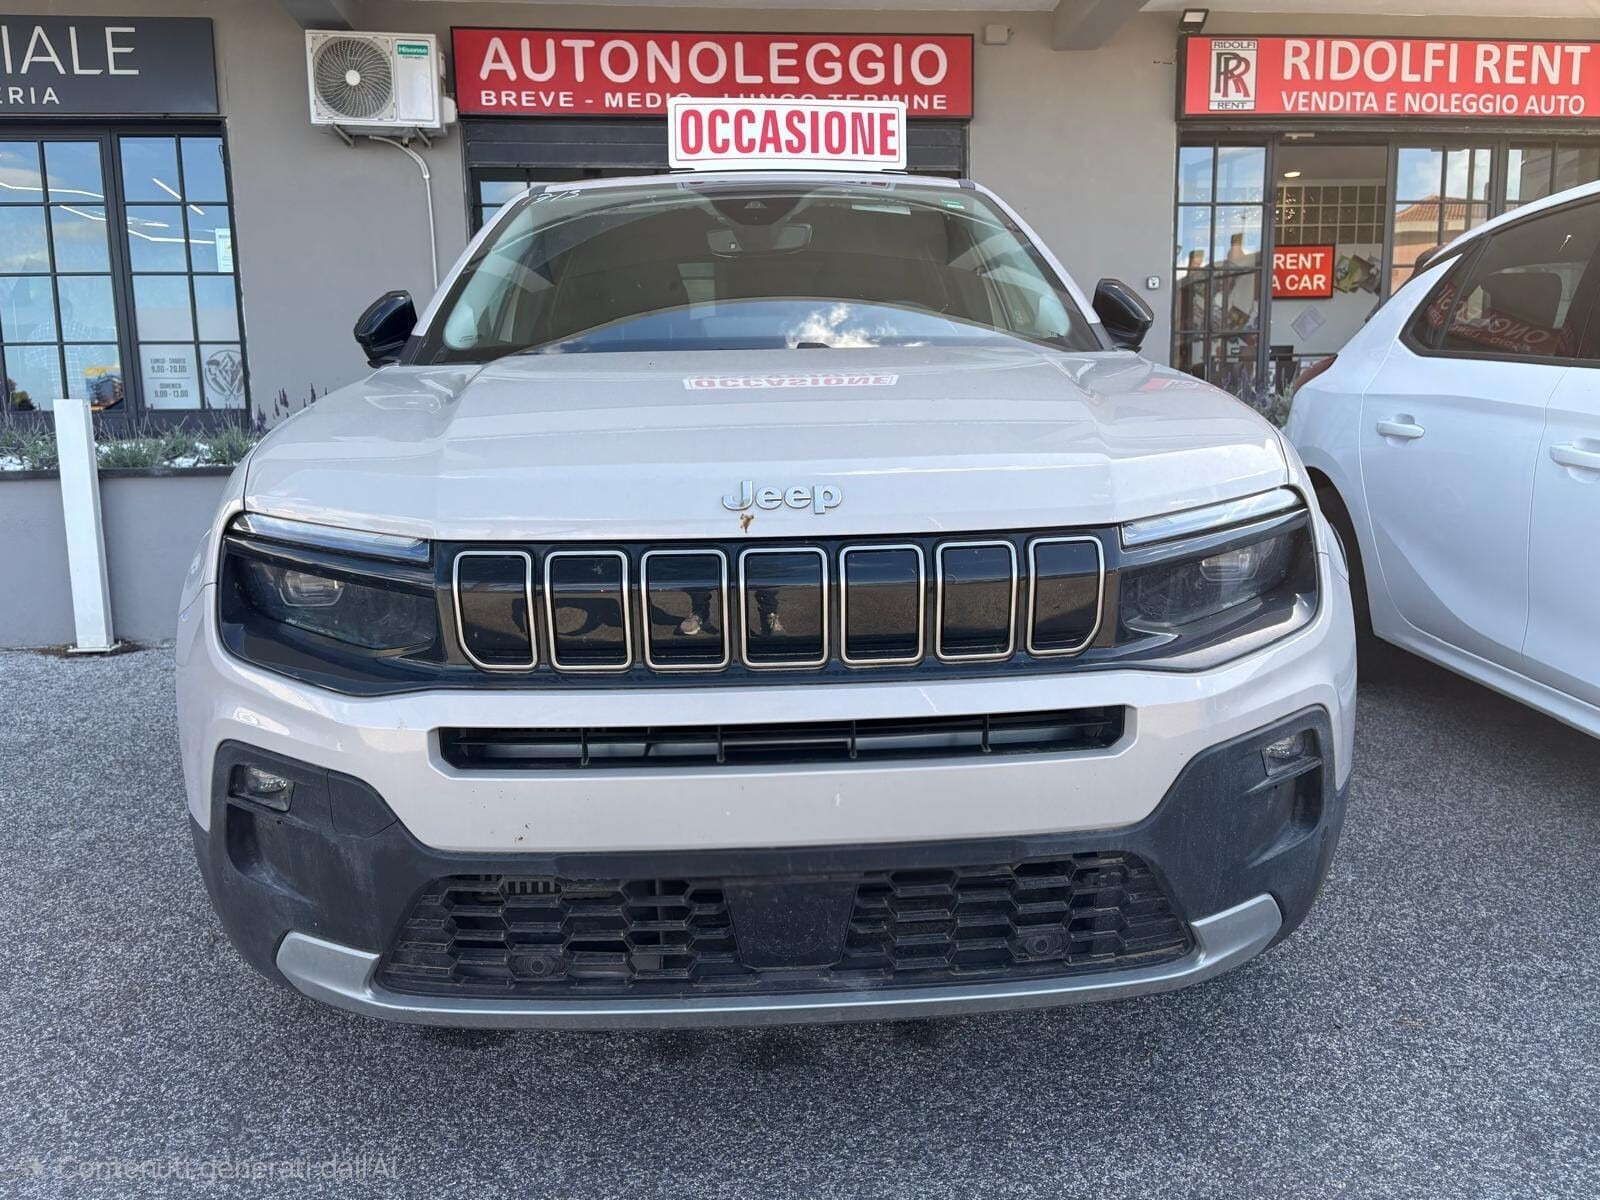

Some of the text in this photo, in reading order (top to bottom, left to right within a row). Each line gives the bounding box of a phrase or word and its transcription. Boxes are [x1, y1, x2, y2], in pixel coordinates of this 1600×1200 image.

[1, 25, 140, 75] IALE
[1213, 41, 1256, 49] RIDOLFI
[479, 36, 948, 86] AUTONOLEGGIO
[1283, 39, 1591, 85] RIDOLFI RENT
[0, 86, 60, 105] RIA
[480, 90, 574, 108] BREVE
[1281, 90, 1585, 115] VENDITA E NOLEGGIO AUTO
[680, 108, 897, 156] OCCASIONE
[1273, 253, 1325, 270] RENT
[1285, 273, 1326, 291] CAR
[721, 480, 842, 514] Jeep
